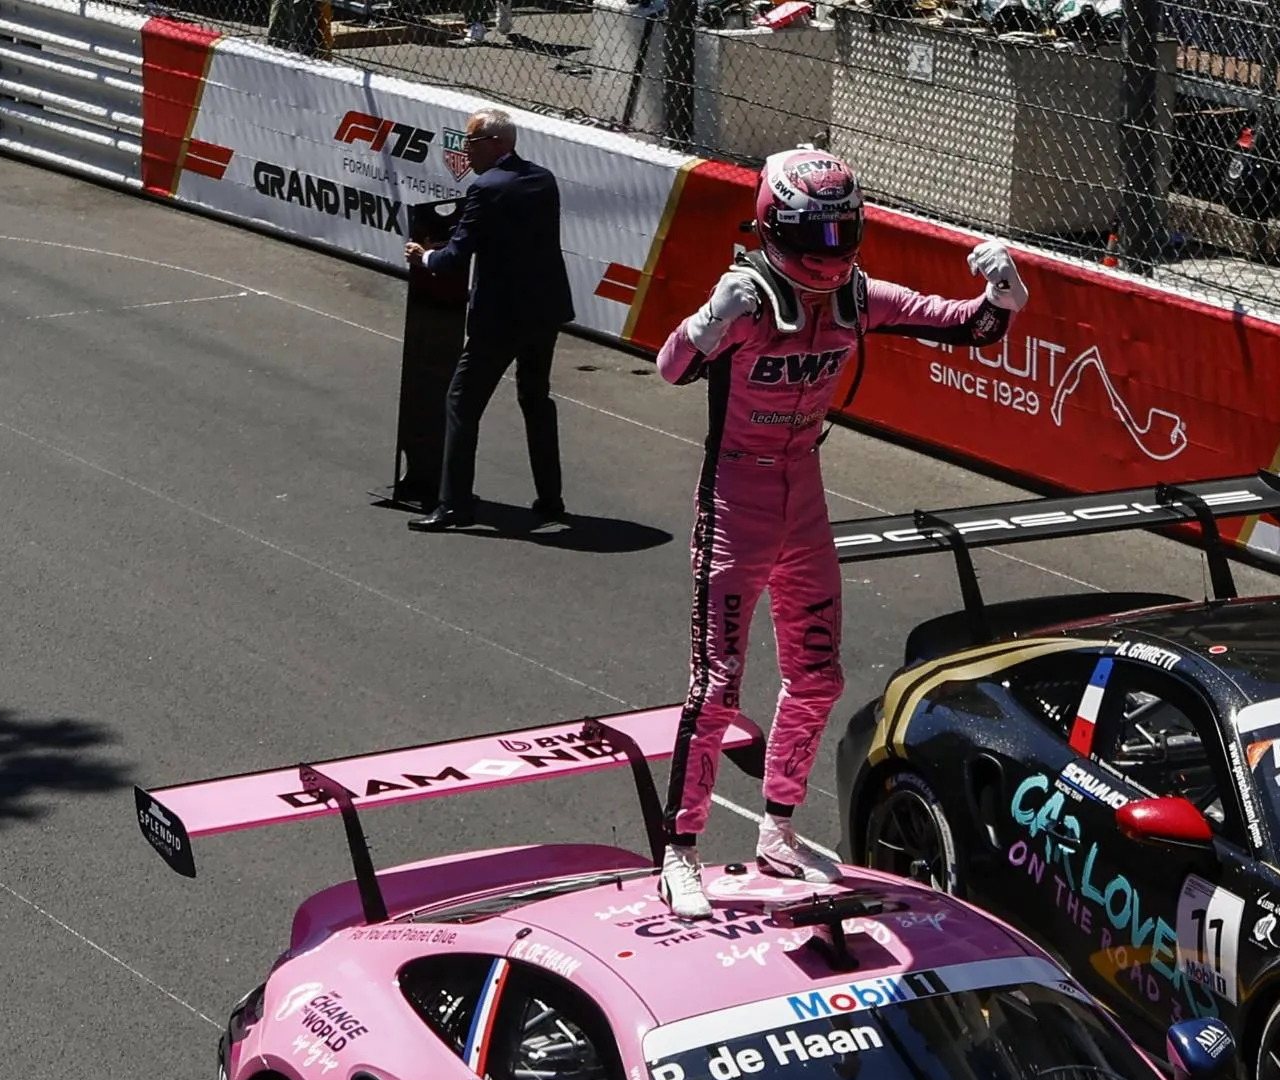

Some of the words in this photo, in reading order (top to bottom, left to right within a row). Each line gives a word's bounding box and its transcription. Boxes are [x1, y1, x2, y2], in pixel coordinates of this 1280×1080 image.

[343, 157, 391, 182] FORMULA
[407, 175, 427, 194] TAG
[773, 180, 796, 200] BWT
[253, 160, 340, 216] GRAND
[343, 186, 404, 236] PRIX
[748, 348, 850, 384] BWT
[930, 361, 988, 399] SINCE
[993, 379, 1040, 415] 1929
[1127, 643, 1181, 671] GHIRETTI
[139, 808, 181, 851] SPLENDID
[1008, 840, 1045, 884] ON
[1054, 874, 1093, 936] THE
[368, 928, 383, 941] You
[384, 928, 399, 941] and
[401, 928, 431, 944] Planet
[653, 930, 707, 948] THE
[1191, 907, 1224, 975] 11
[524, 943, 541, 963] DE
[539, 947, 582, 978] HAAN
[1186, 959, 1215, 992] Mobil
[788, 976, 905, 1019] Mobil
[915, 973, 937, 996] 1
[301, 1010, 347, 1053] WORLD
[309, 995, 369, 1041] CHANGE
[766, 1025, 883, 1066] Haan
[1195, 1024, 1225, 1052] ADA
